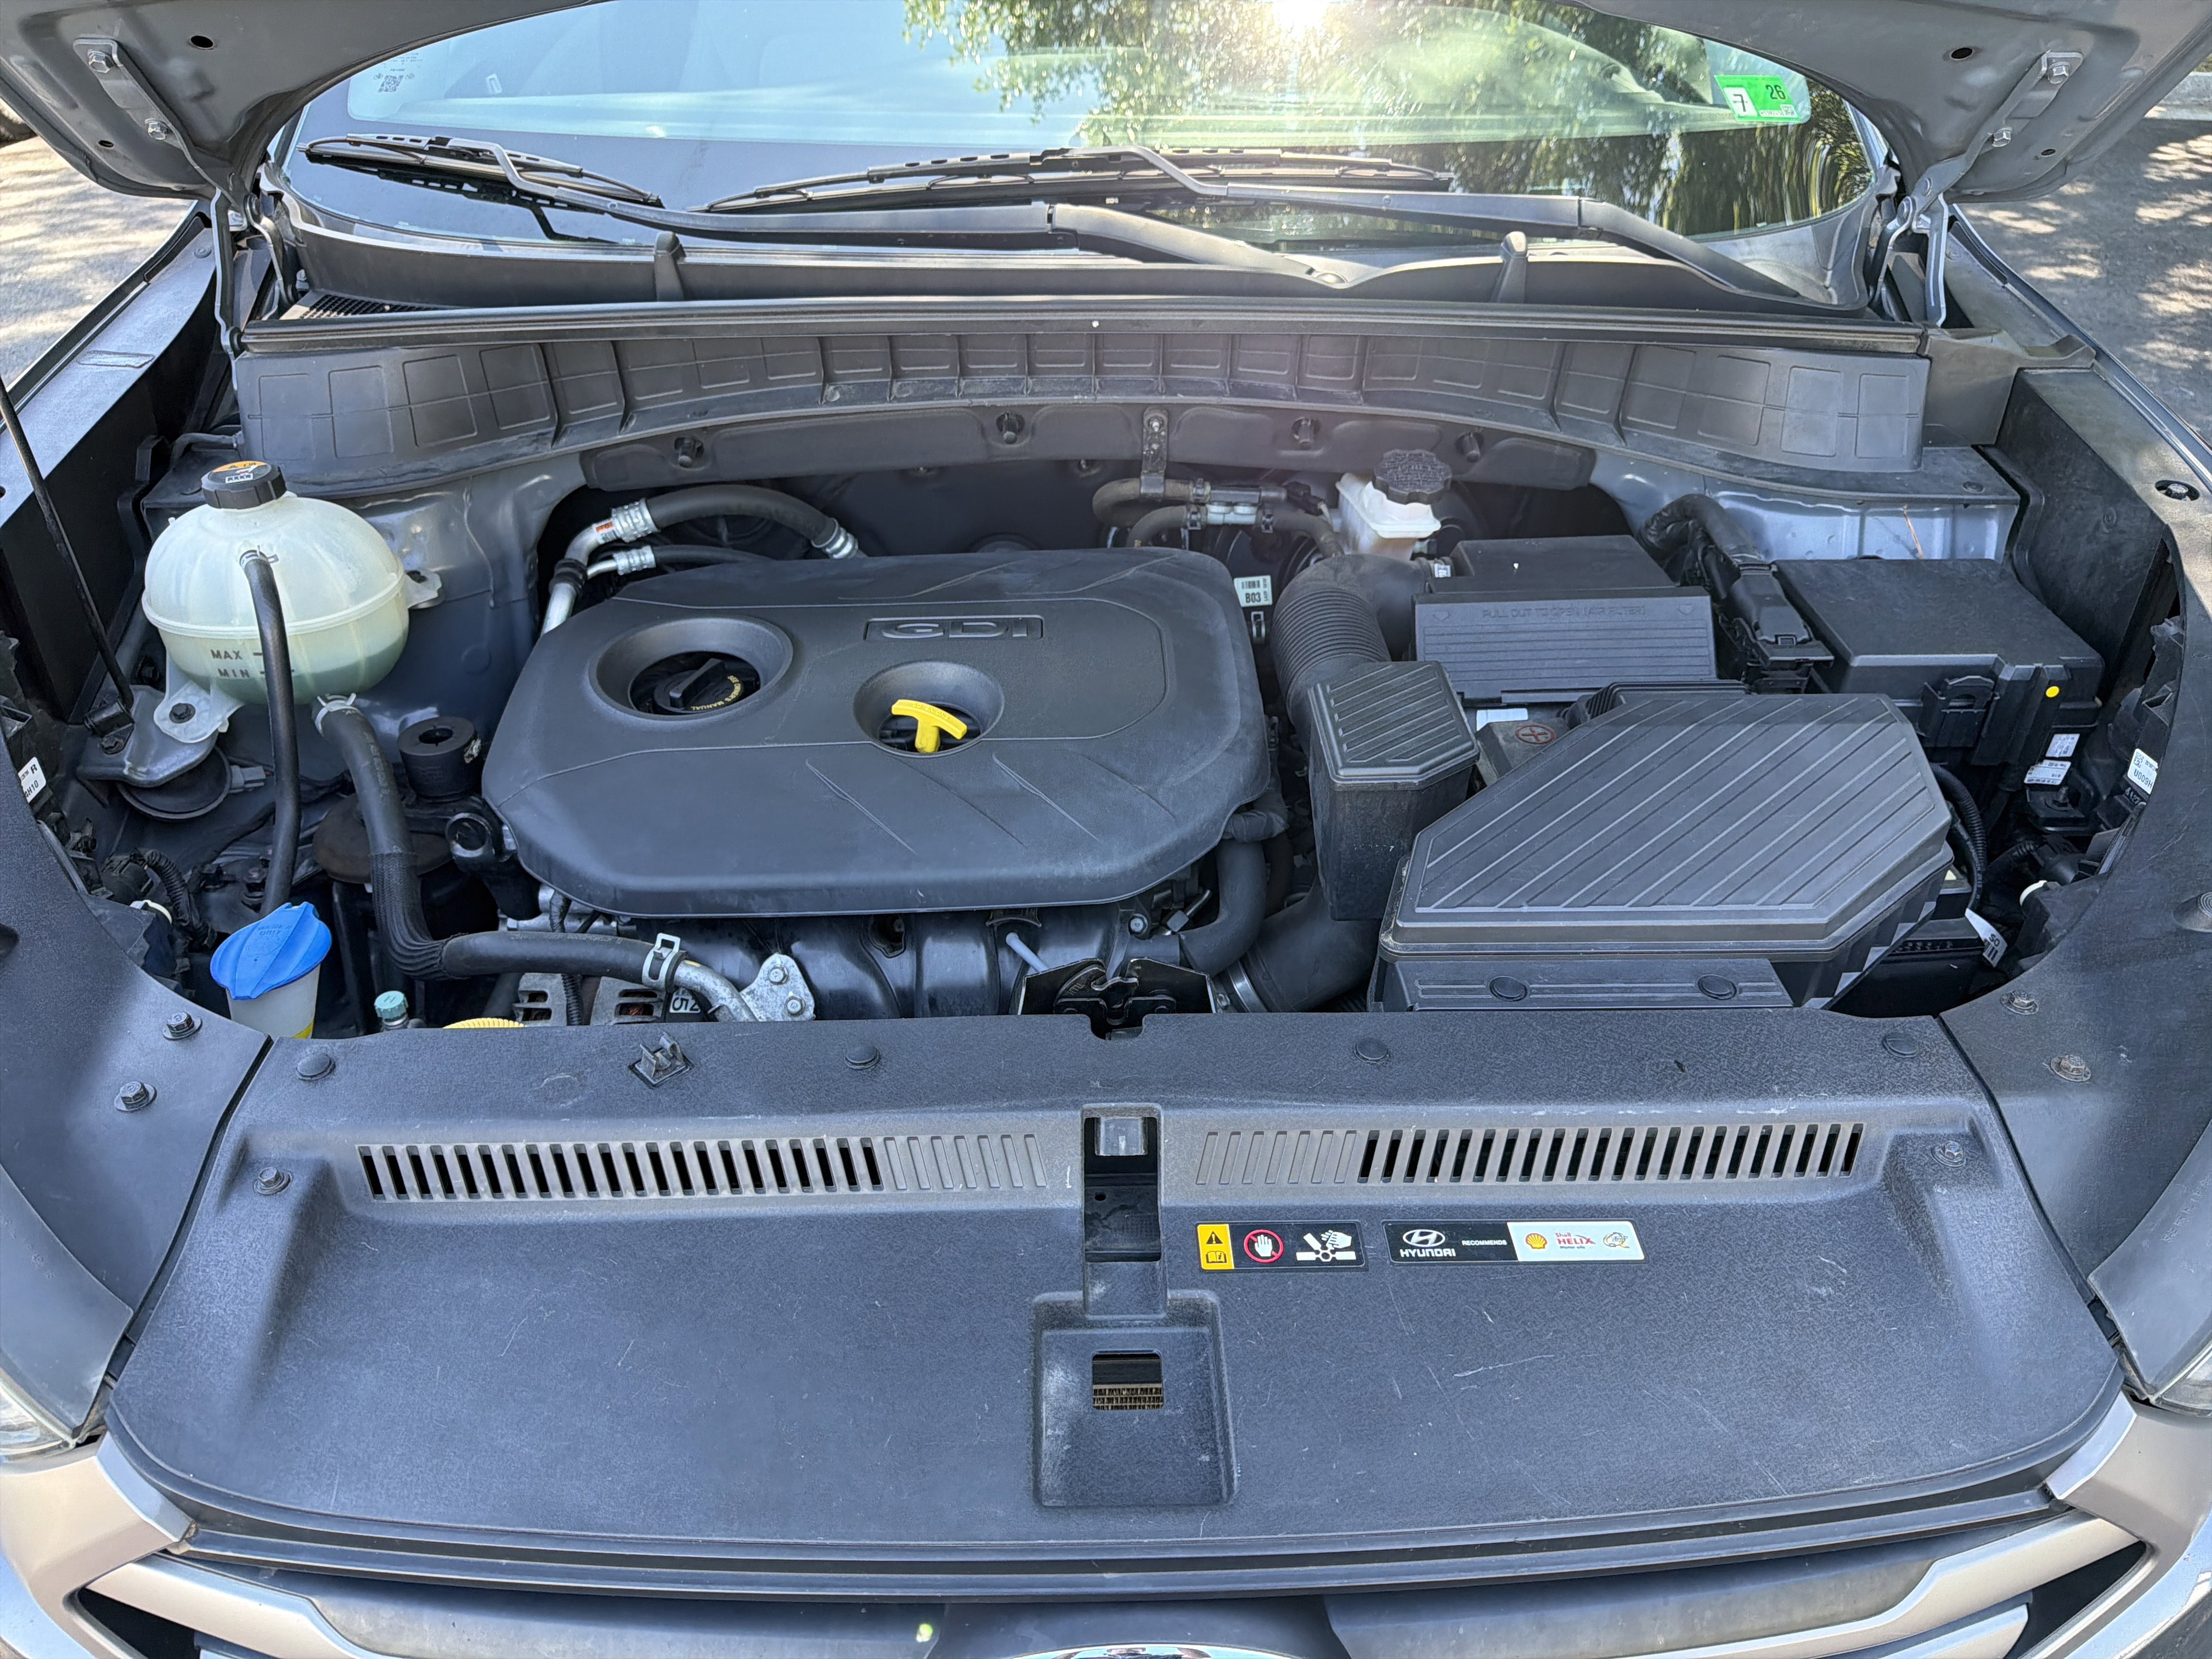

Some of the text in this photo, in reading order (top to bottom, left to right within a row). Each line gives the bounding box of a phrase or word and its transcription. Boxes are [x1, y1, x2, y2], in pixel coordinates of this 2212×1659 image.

[1765, 84, 1786, 100] 26
[1733, 93, 1746, 112] 7
[1245, 592, 1261, 603] B03
[882, 621, 1028, 639] GDI
[211, 649, 242, 660] MAX
[217, 668, 250, 678] MIN
[691, 701, 725, 710] MANUAL
[30, 764, 37, 774] R
[1400, 1248, 1457, 1257] HYUNDAI
